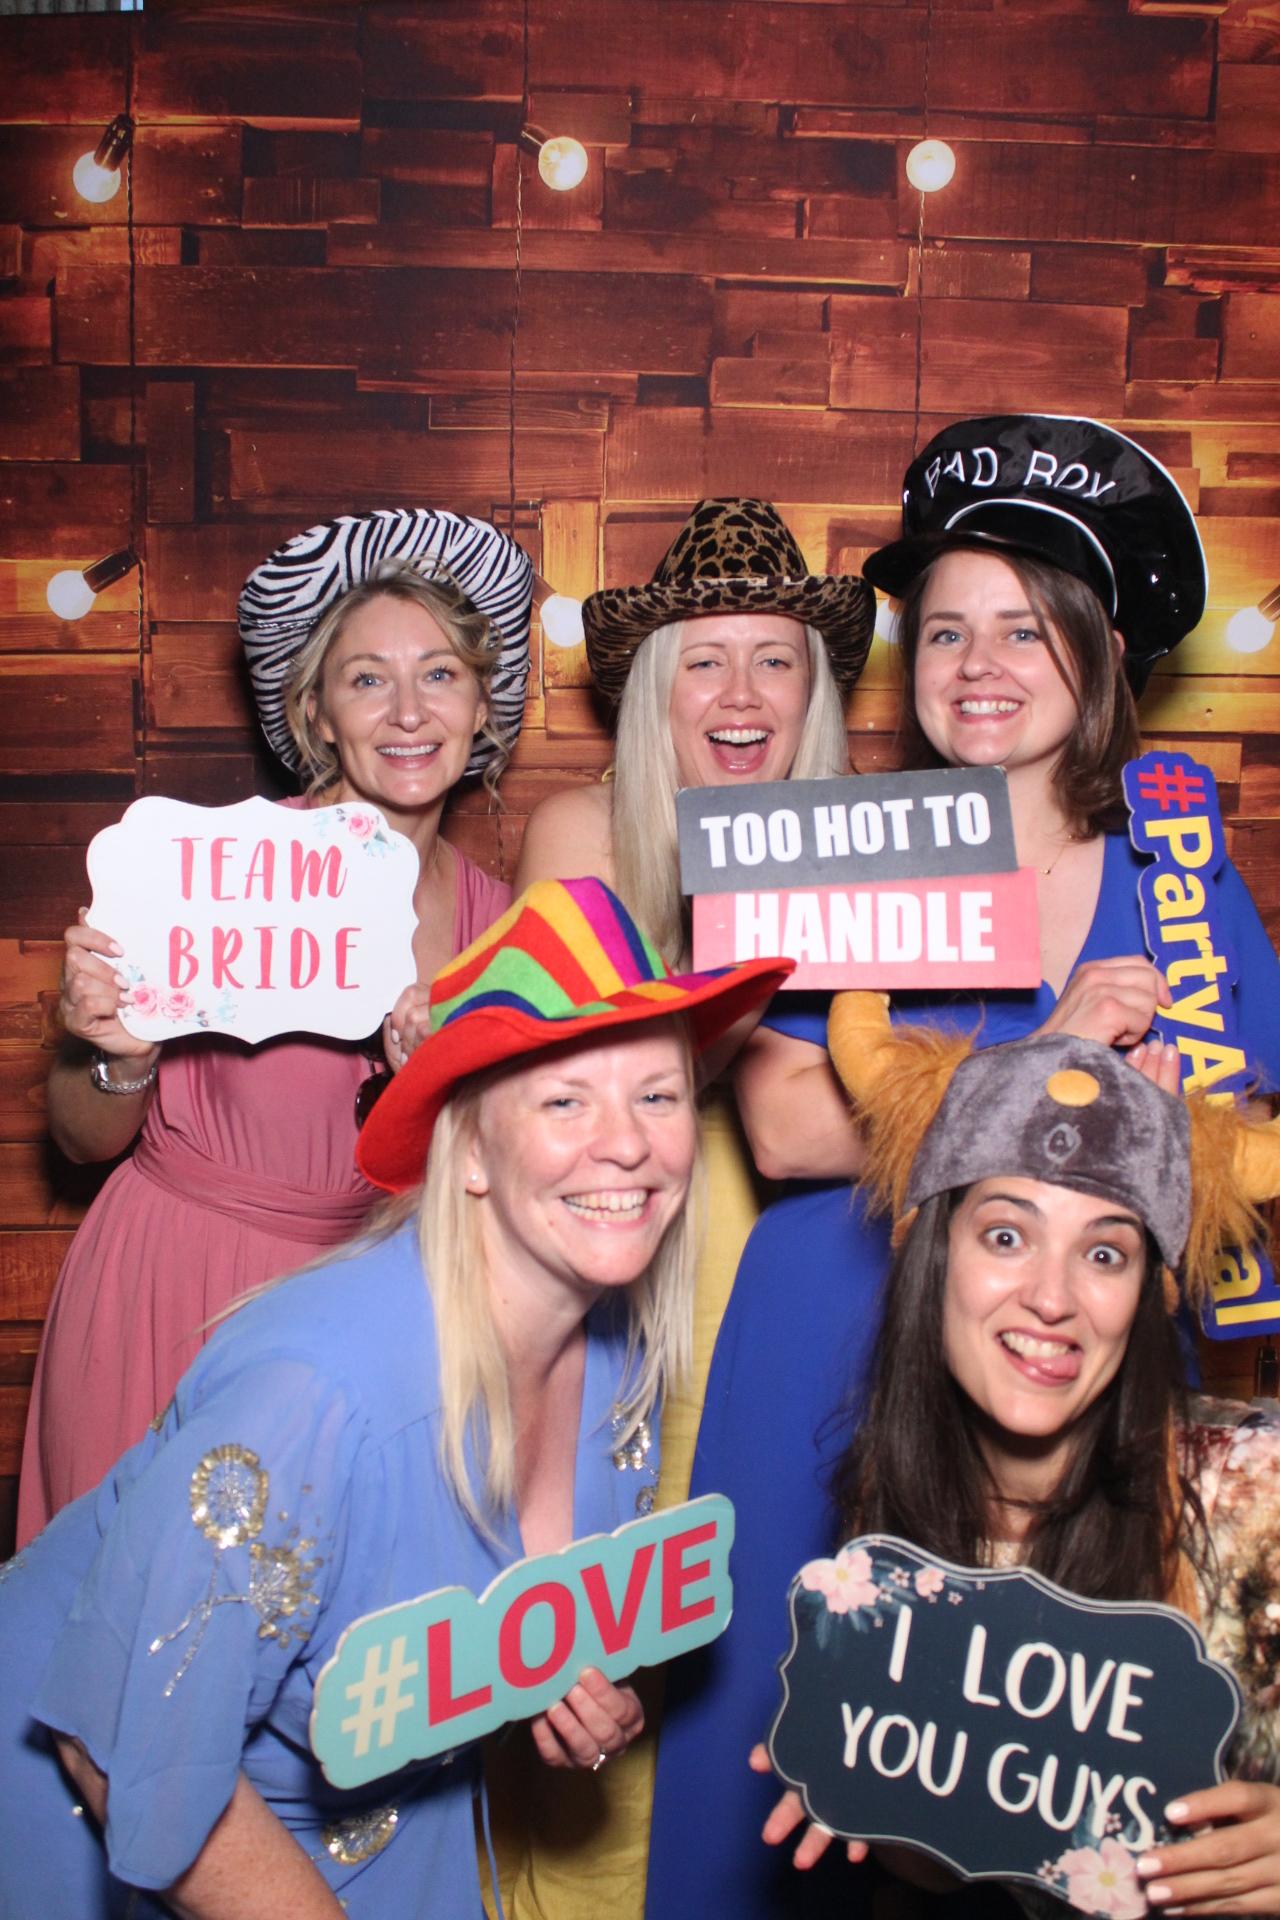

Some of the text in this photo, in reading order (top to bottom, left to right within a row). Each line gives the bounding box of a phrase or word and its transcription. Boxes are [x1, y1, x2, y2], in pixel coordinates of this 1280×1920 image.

[924, 446, 1116, 499] BAD BOY
[700, 792, 991, 868] TOO HOT TO
[171, 837, 348, 902] TEAM
[168, 925, 362, 990] BRIDE
[734, 891, 996, 963] HANDLE
[1138, 763, 1280, 1326] #PartyAal
[340, 1520, 718, 1759] #LOVE
[889, 1604, 1154, 1742] I LOVE
[840, 1702, 1157, 1852] YOU GUYS
